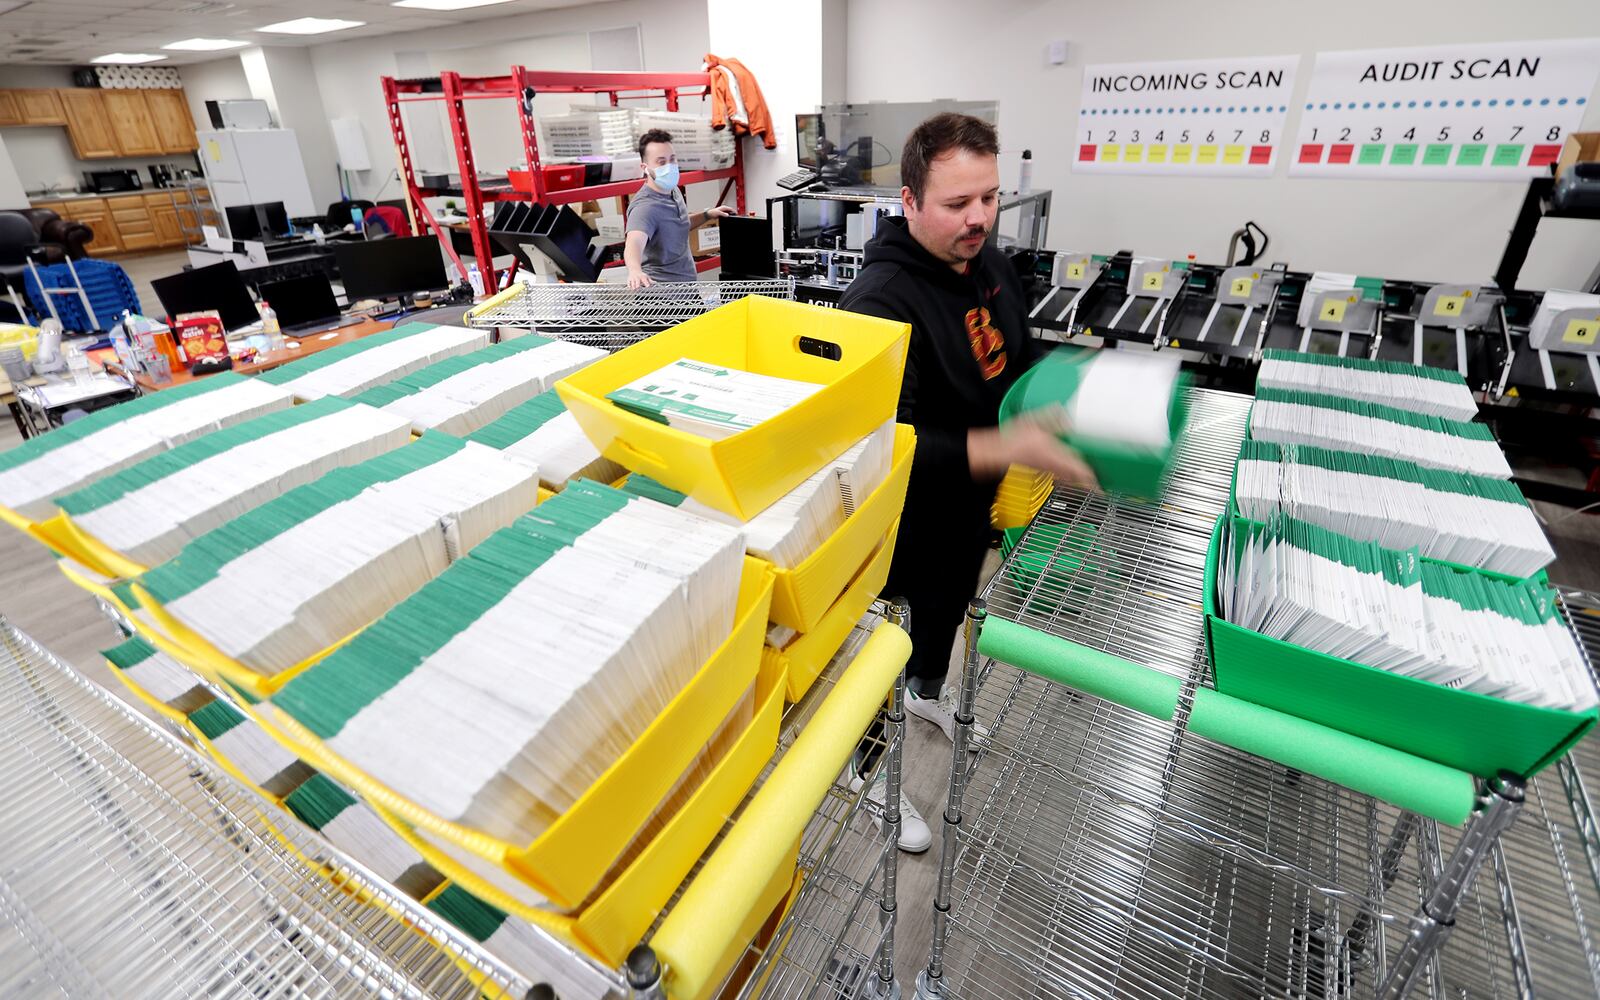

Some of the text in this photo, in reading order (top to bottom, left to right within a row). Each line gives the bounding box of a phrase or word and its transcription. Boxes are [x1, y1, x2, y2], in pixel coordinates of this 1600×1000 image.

[1359, 57, 1541, 83] AUDIT SCAN
[1092, 70, 1284, 93] INCOMING SCAN
[1087, 130, 1270, 143] 1 2 3 4 5 6 7 8
[1312, 125, 1561, 141] 1 2 3 4 5 6 7 8
[1327, 308, 1335, 316] 4
[1446, 302, 1454, 310] 5
[1576, 328, 1586, 337] 6
